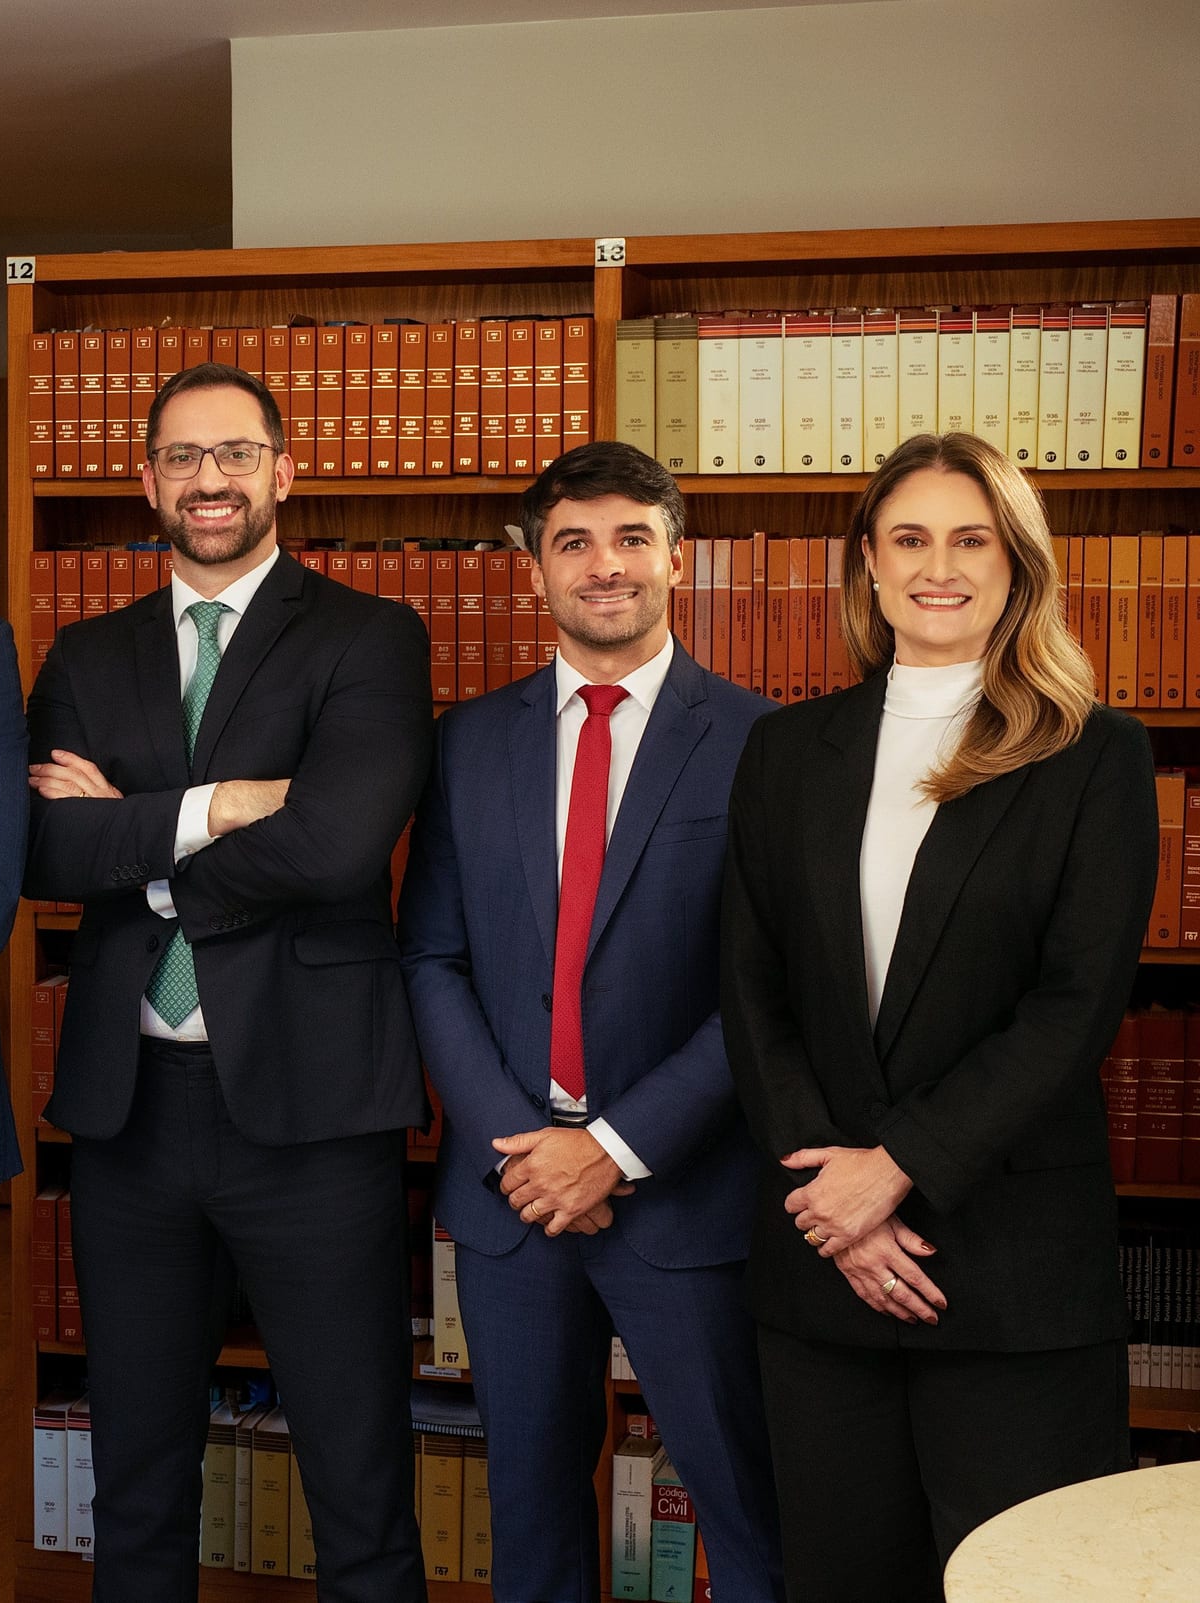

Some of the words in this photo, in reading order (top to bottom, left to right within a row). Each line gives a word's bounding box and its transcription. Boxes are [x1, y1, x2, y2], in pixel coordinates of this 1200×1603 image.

[597, 244, 624, 262] 13
[8, 262, 33, 278] 12
[659, 1487, 688, 1500] Código
[658, 1498, 687, 1516] Civil
